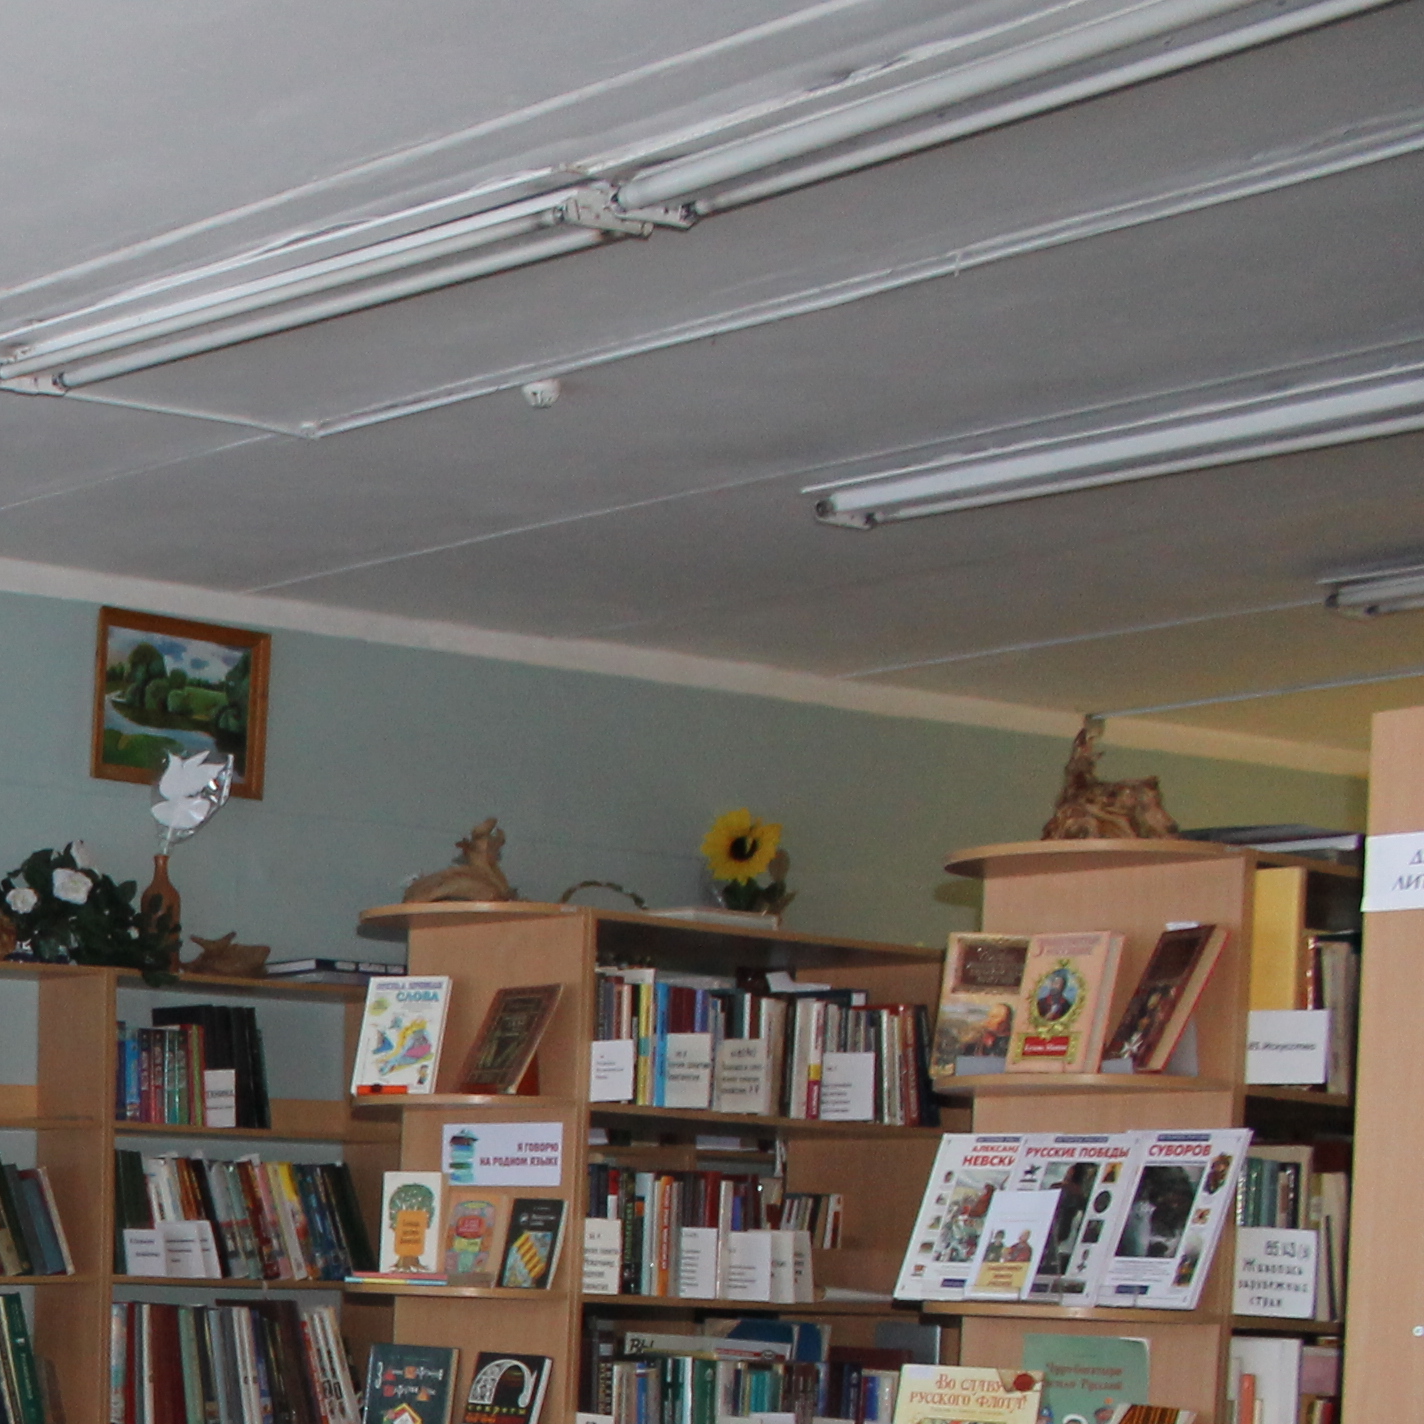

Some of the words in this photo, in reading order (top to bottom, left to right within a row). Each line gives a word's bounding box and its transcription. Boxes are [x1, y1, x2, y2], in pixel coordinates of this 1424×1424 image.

[525, 1143, 559, 1152] ГОВОРЮ
[1025, 1147, 1075, 1158] РУССКИЕ
[1079, 1147, 1130, 1159] ПОБЕДЫ
[1148, 1144, 1212, 1157] СУВОРОВ
[480, 1157, 490, 1166] НА
[493, 1157, 527, 1167] РОДНОМ
[530, 1157, 558, 1166] ЯЗЫКЕ
[910, 1391, 971, 1406] РУССКОГО
